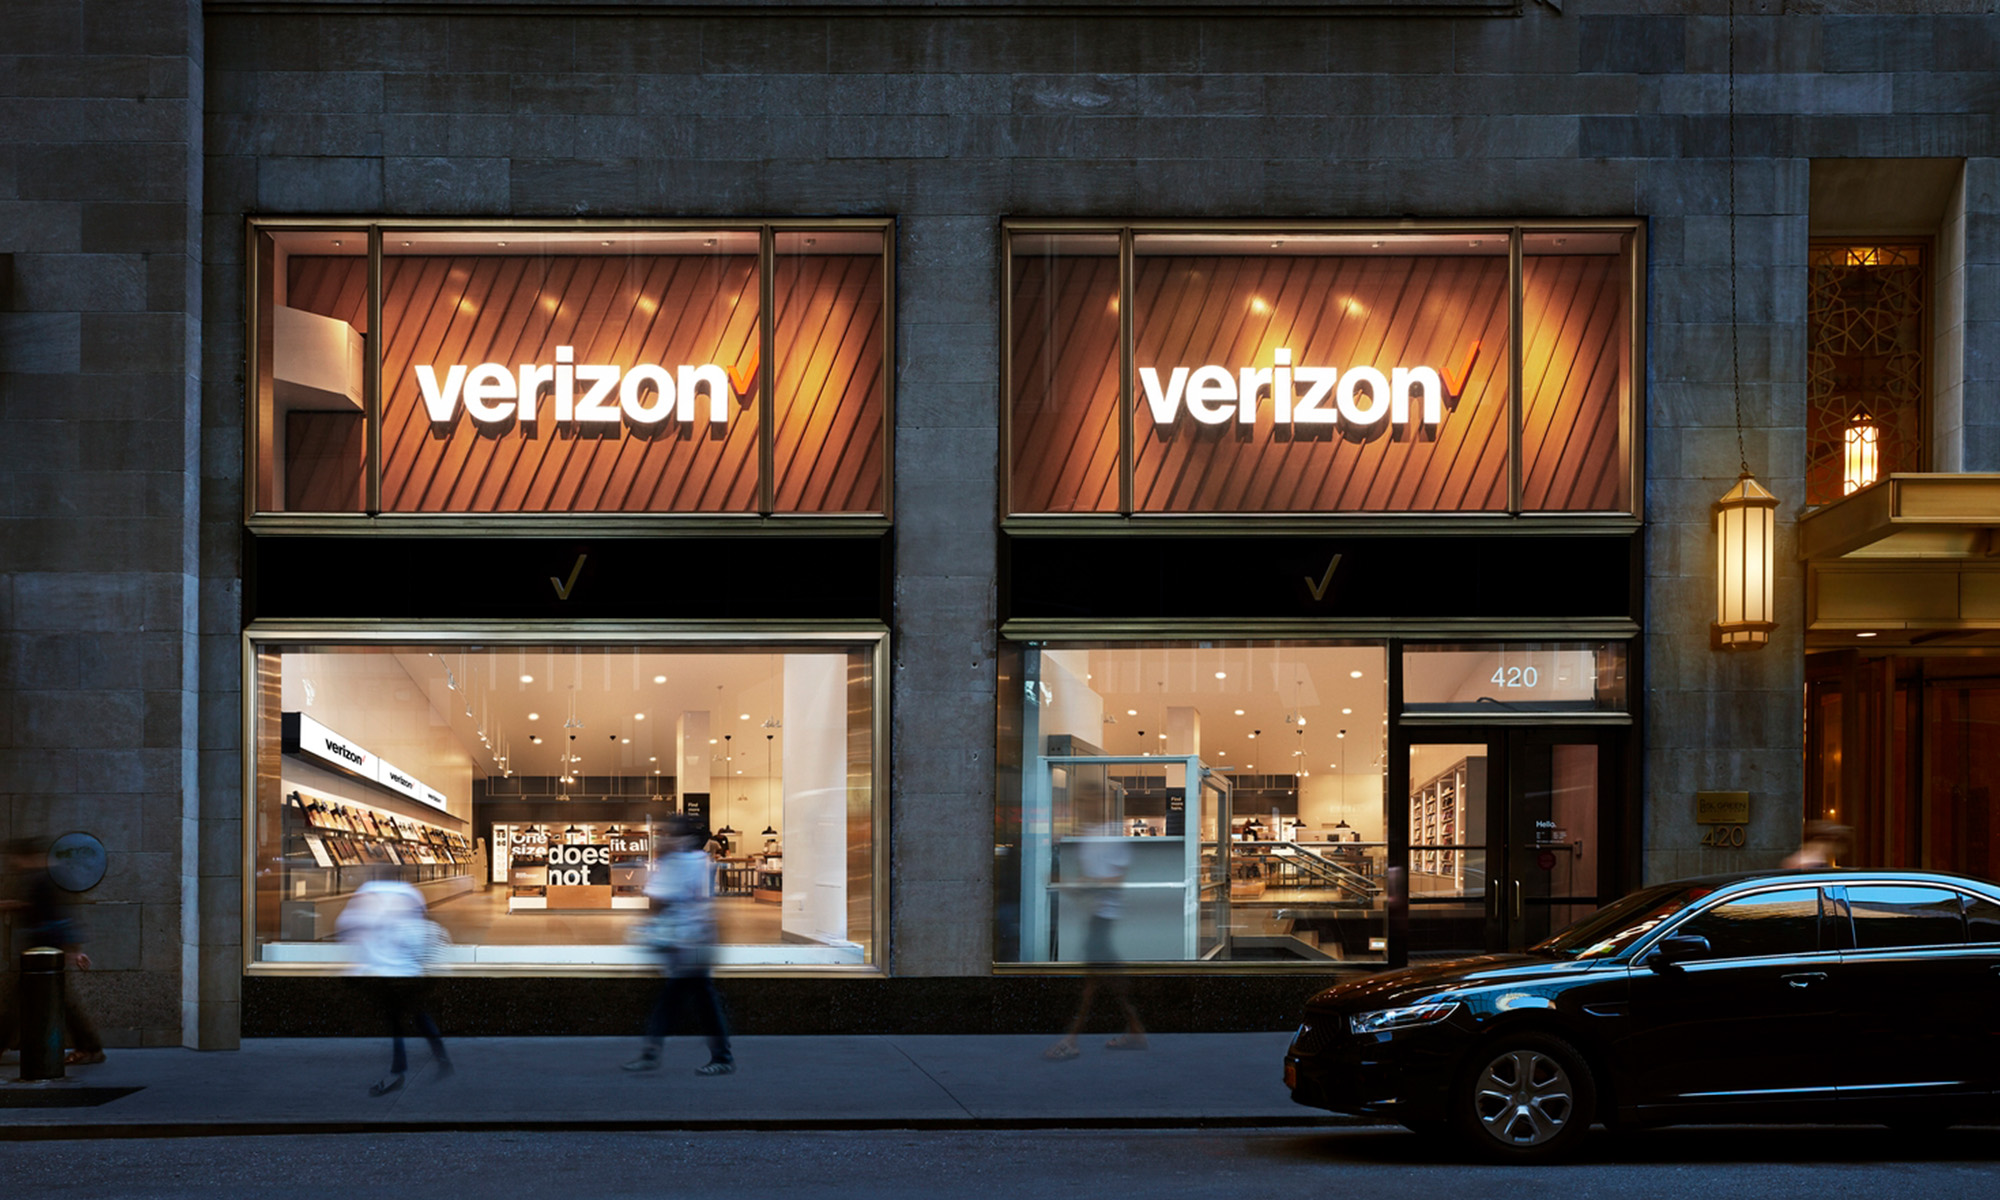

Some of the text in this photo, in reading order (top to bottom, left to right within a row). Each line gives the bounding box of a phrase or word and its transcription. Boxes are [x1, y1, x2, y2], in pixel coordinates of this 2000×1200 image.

[414, 345, 729, 423] verizon
[1138, 347, 1442, 425] verizon
[1490, 666, 1538, 688] 420
[325, 738, 363, 766] verizon
[389, 772, 413, 789] verizon
[512, 833, 548, 844] One
[610, 838, 649, 851] fit all
[1700, 825, 1747, 847] 420
[511, 844, 548, 856] size
[548, 865, 591, 885] not
